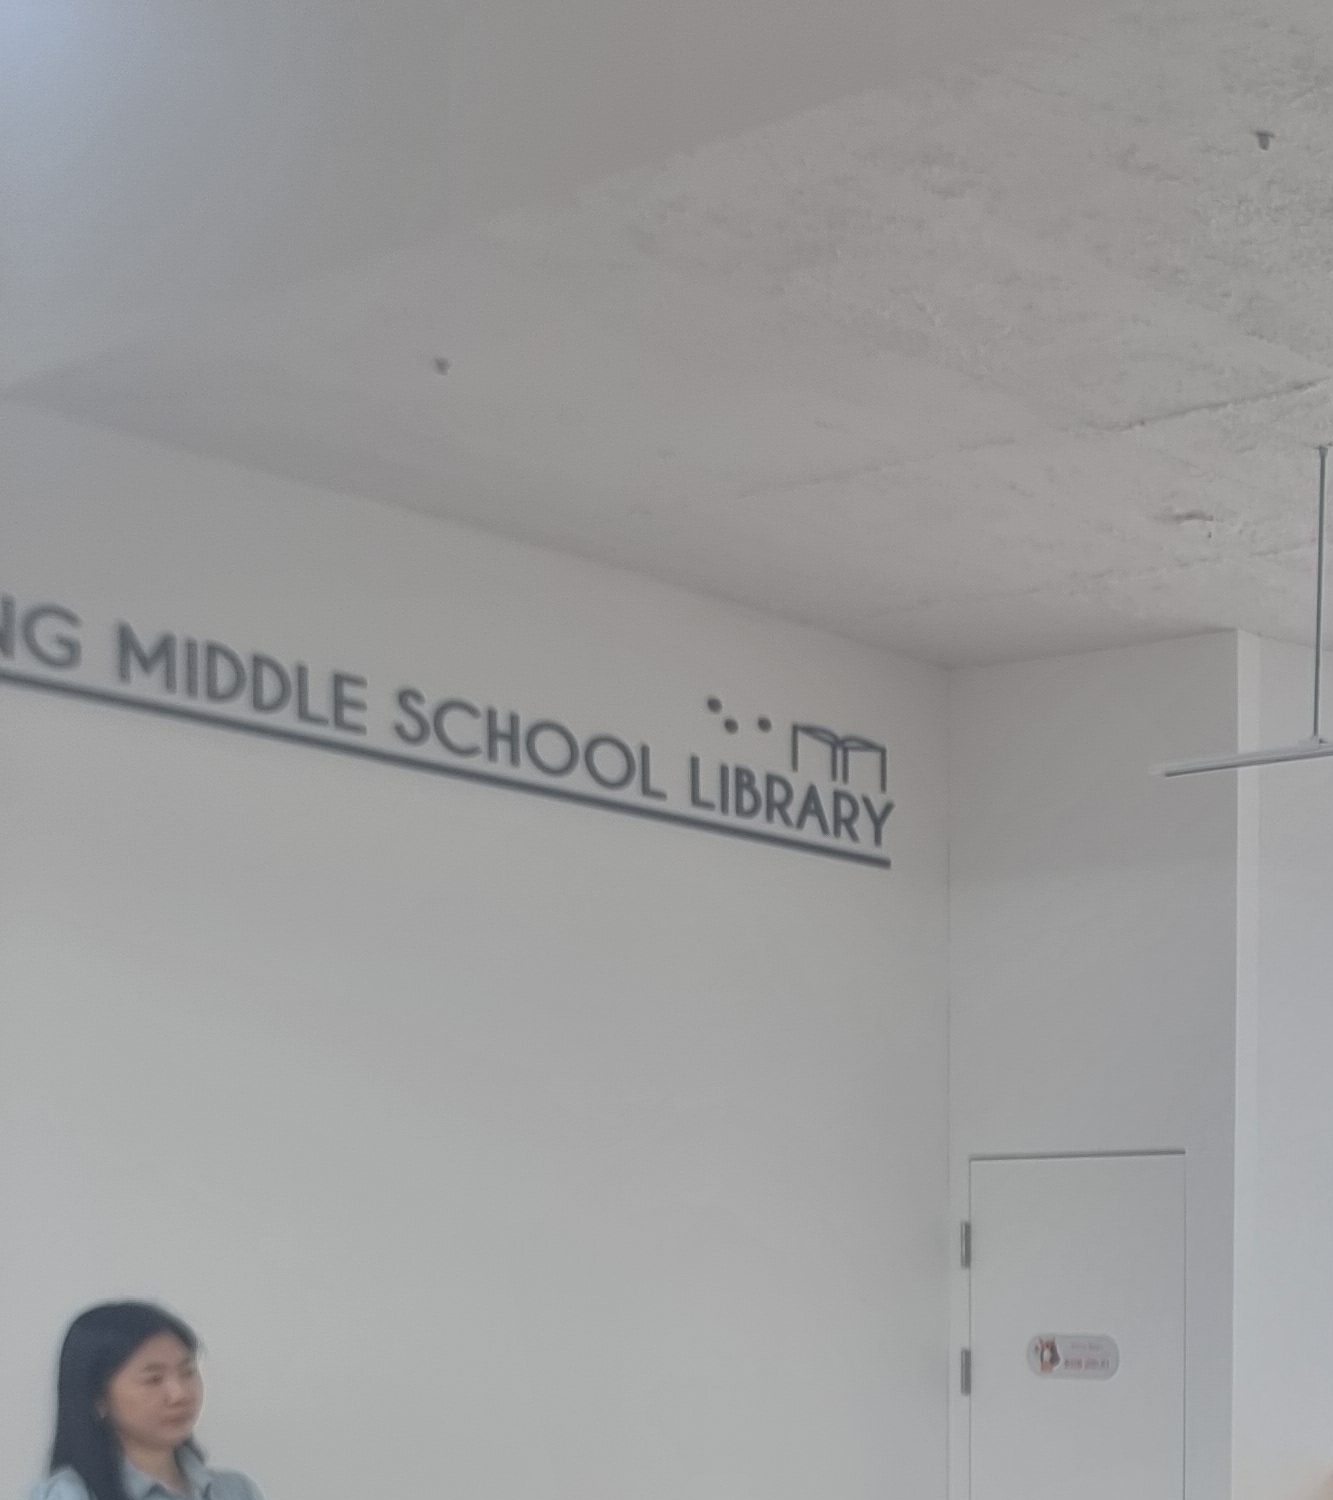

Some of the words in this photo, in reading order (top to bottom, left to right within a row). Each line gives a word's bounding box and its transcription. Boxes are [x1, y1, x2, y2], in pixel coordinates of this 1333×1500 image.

[117, 621, 369, 736] MIDDLE
[394, 687, 668, 801] SCHOOL
[690, 754, 895, 848] LIBRARY
